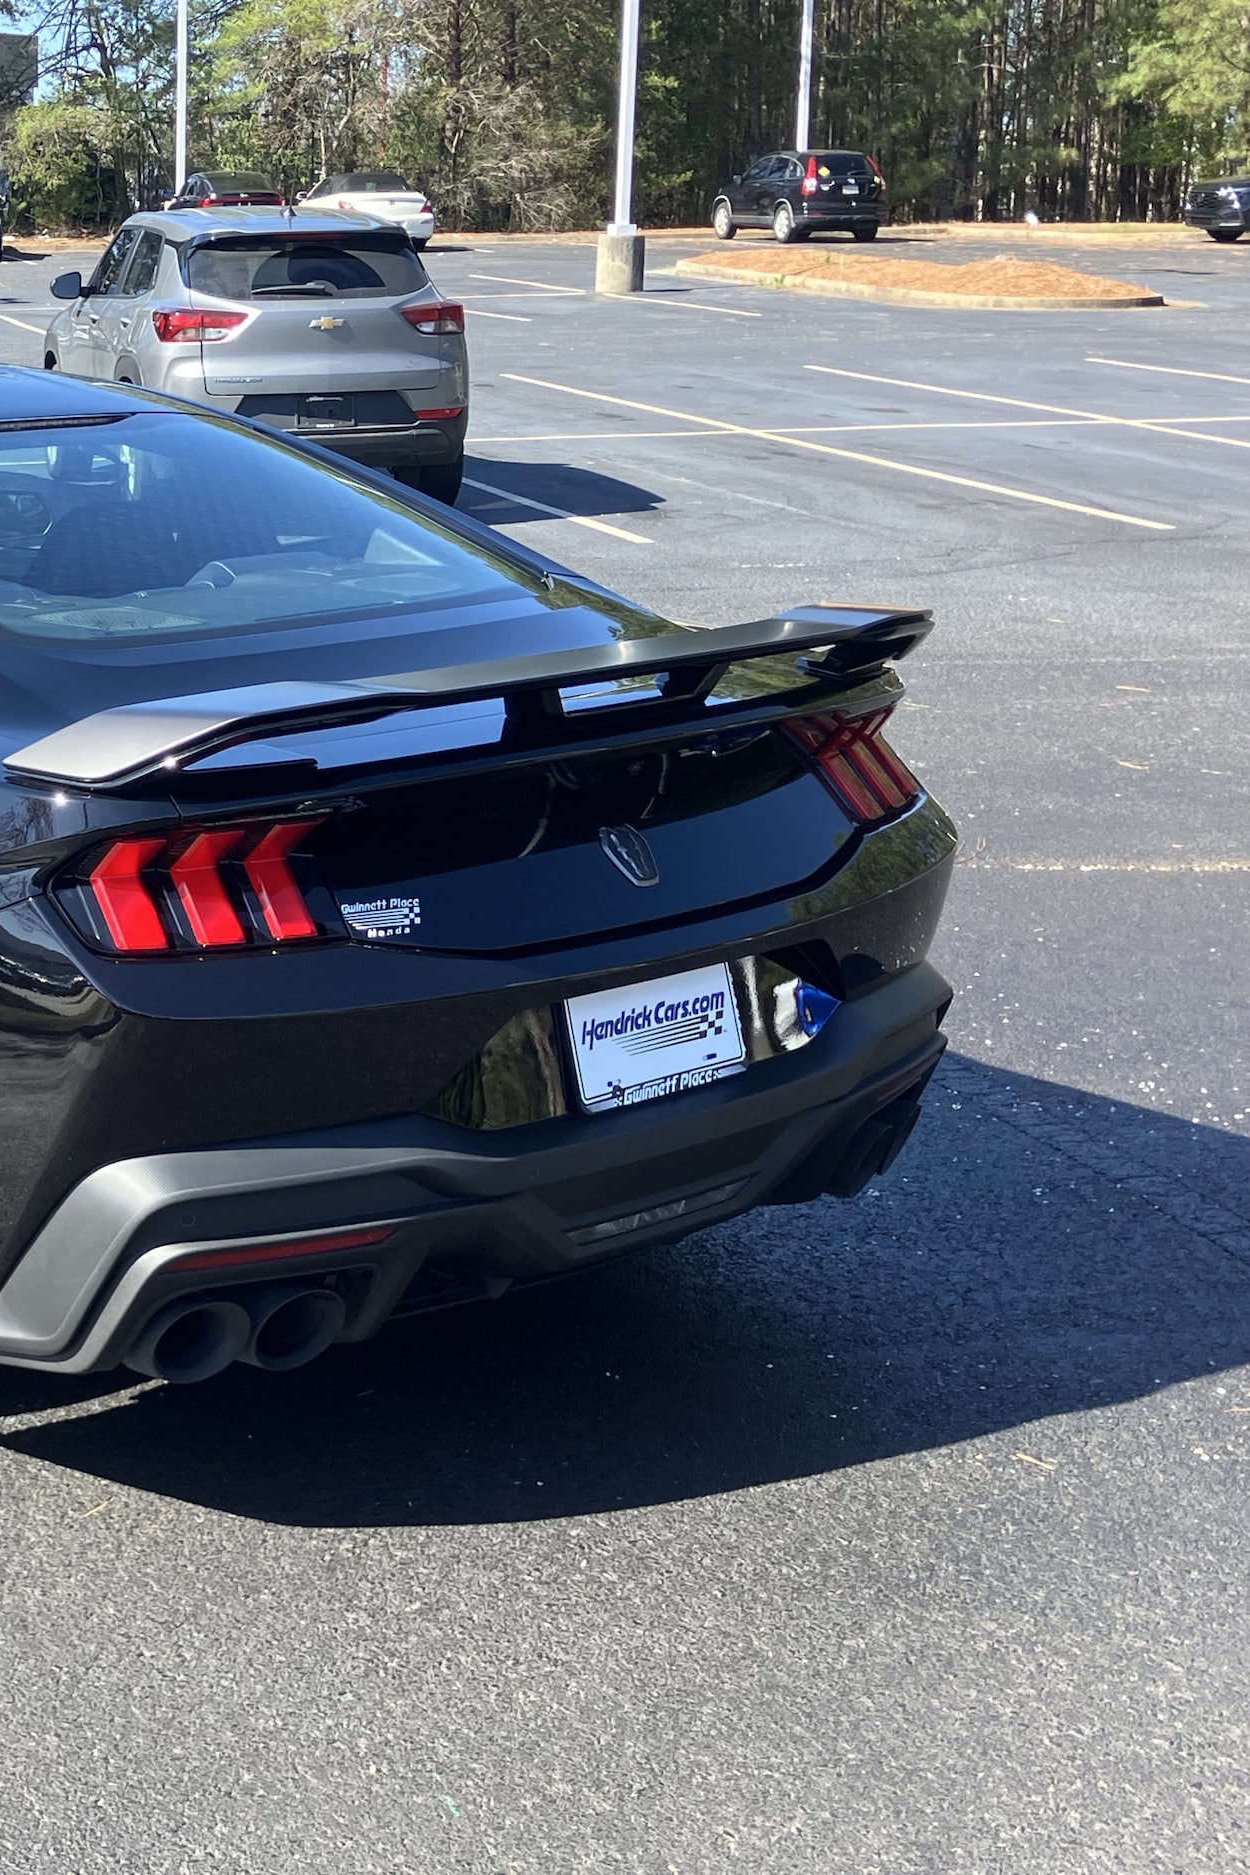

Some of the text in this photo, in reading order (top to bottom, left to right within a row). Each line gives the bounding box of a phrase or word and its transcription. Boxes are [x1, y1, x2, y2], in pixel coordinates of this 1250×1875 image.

[340, 898, 420, 914] Gwinnett Place
[367, 926, 411, 938] Honda
[623, 1069, 713, 1106] Gwinnett Place
